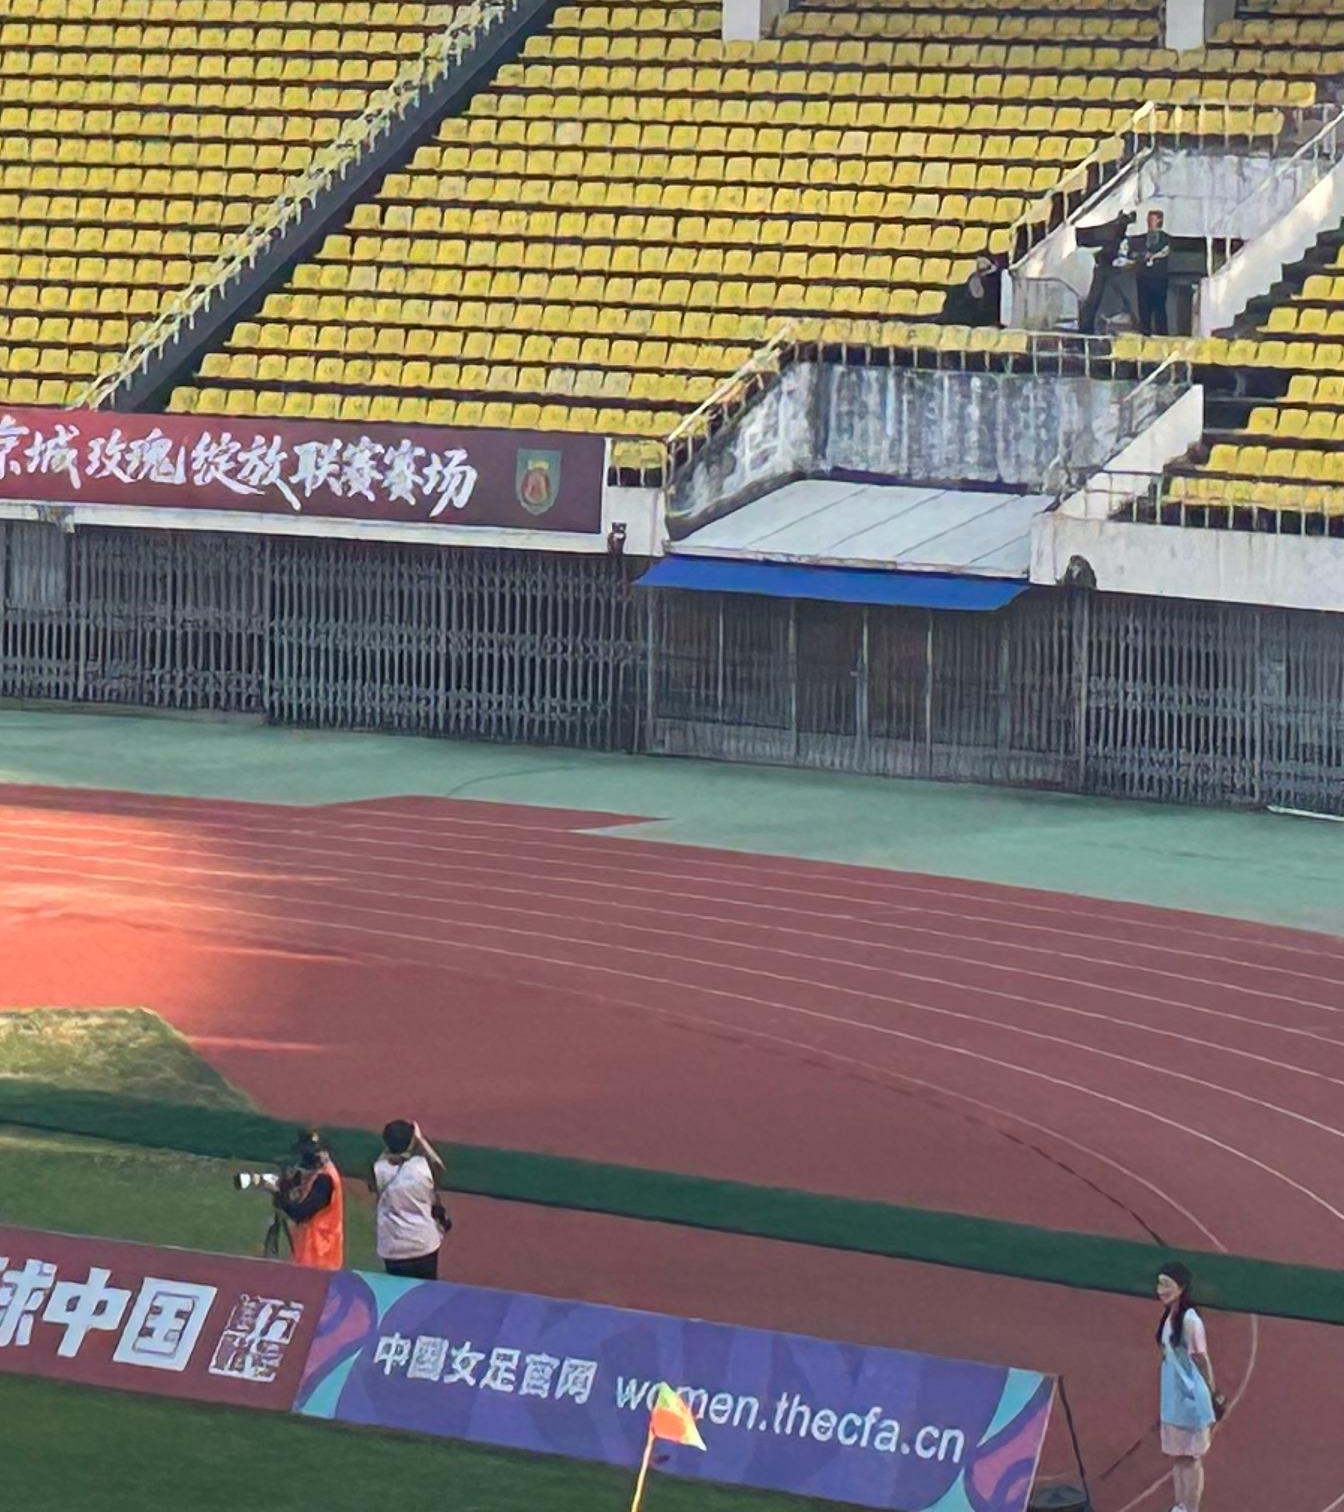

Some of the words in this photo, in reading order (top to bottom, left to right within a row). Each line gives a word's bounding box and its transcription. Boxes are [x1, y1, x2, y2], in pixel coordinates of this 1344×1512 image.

[373, 1332, 598, 1405] 中国女足官网
